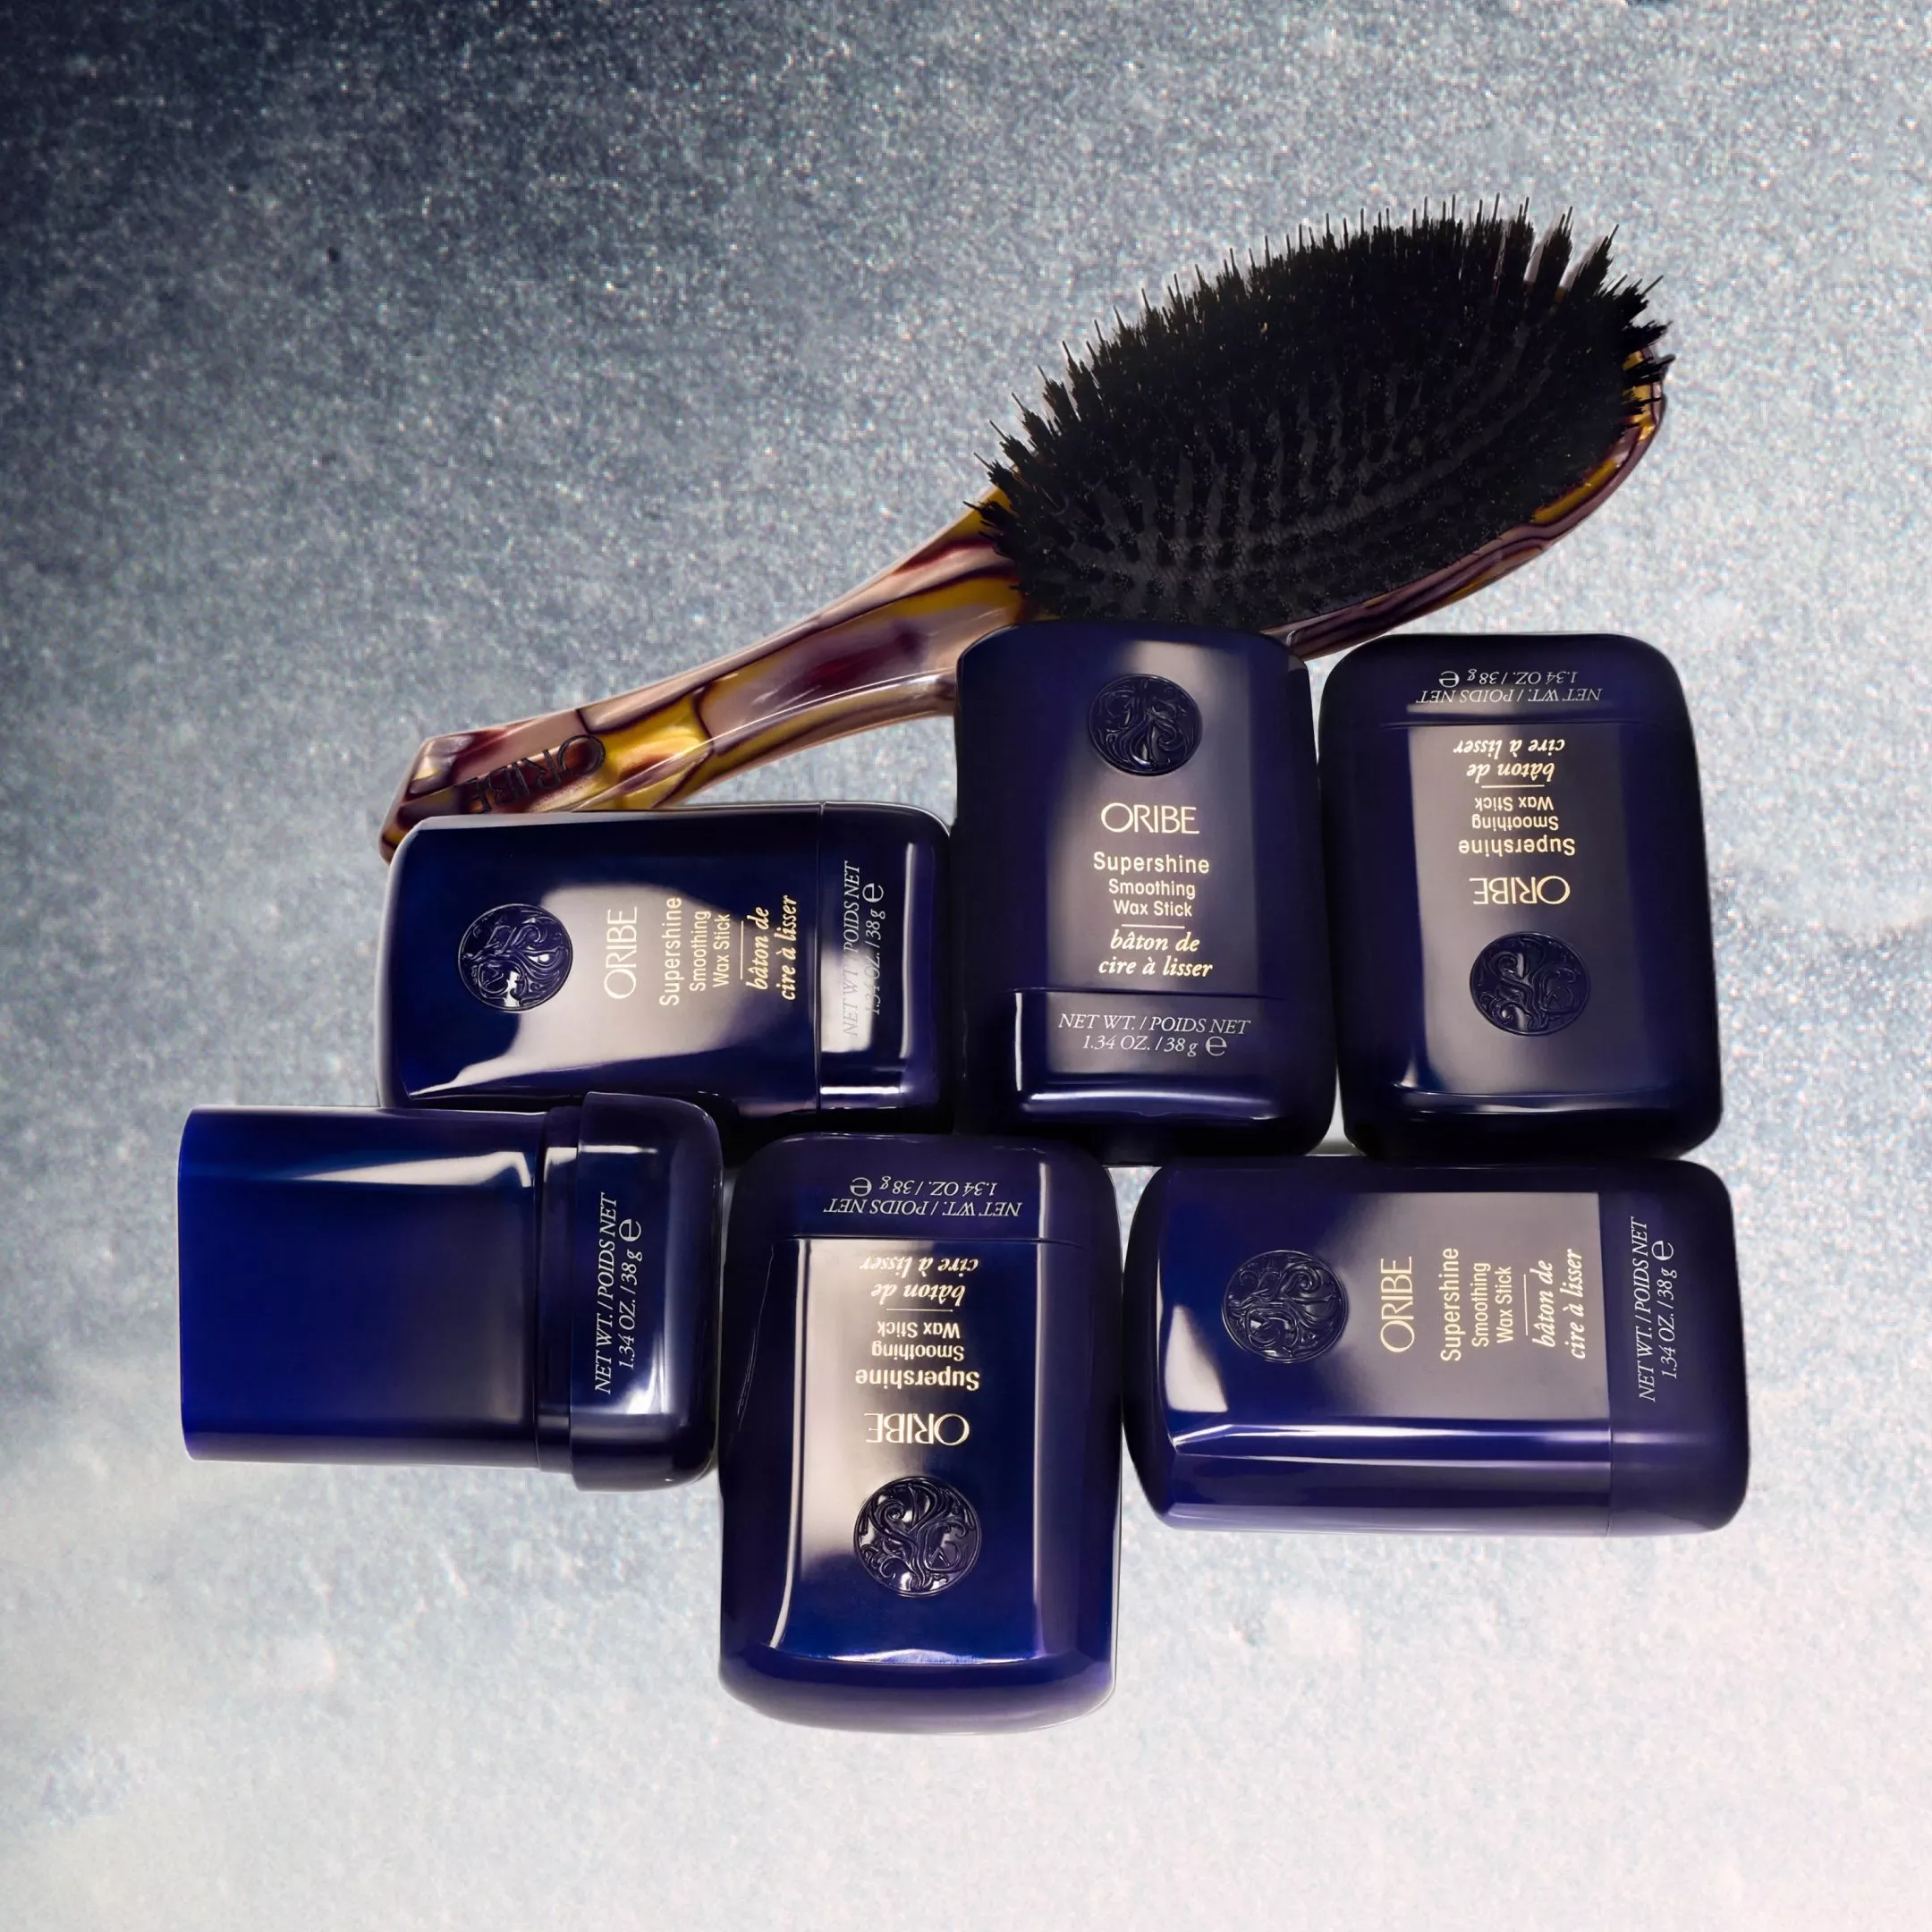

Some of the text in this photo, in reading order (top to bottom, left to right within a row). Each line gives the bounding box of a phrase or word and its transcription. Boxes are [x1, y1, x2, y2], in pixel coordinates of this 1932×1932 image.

[1467, 669, 1477, 681] g
[1479, 673, 1499, 685] 38
[1513, 671, 1540, 684] OZ.
[1547, 672, 1578, 683] 1.34
[1415, 690, 1456, 704] NET
[1460, 689, 1515, 703] POIDS
[1529, 689, 1559, 701] WT.
[1565, 688, 1603, 701] NET
[1453, 739, 1565, 759] cire à lisser
[462, 734, 606, 813] ORIBE
[1466, 762, 1555, 784] bâton de
[1475, 796, 1555, 812] Wax Stick
[1101, 802, 1199, 834] ORIBE
[1472, 814, 1558, 831] Smoothing
[1459, 835, 1575, 857] Supershine
[1093, 852, 1209, 874] Supershine
[844, 860, 860, 899] NET
[1108, 878, 1195, 900] Smoothing
[1470, 876, 1571, 905] ORIBE
[870, 909, 886, 919] g
[1114, 900, 1192, 917] Wax Stick
[843, 901, 859, 953] POIDS
[866, 920, 880, 940] 38
[659, 897, 684, 1005] Supershine
[690, 911, 711, 991] Smoothing
[713, 914, 730, 987] Wax Stick
[746, 907, 769, 989] bâton de
[774, 895, 797, 1000] cire à lisser
[1110, 929, 1200, 952] bâton de
[604, 906, 637, 999] ORIBE
[864, 952, 880, 979] OZ.
[1098, 956, 1213, 978] cire à lisser
[865, 982, 880, 1015] 1.34
[843, 998, 859, 1037] NET
[1059, 1014, 1100, 1029] NET
[1104, 1015, 1135, 1030] WT.
[1149, 1016, 1206, 1033] POIDS
[1209, 1019, 1250, 1035] NET
[1082, 1036, 1115, 1050] 1.34
[1120, 1037, 1149, 1051] OZ.
[1164, 1038, 1185, 1052] 38
[1187, 1041, 1199, 1056] g
[879, 1176, 891, 1190] g
[892, 1179, 915, 1195] 38
[928, 1182, 959, 1196] OZ.
[963, 1182, 998, 1196] 1.34
[599, 1192, 617, 1237] NET
[823, 1199, 868, 1213] NET
[869, 1199, 929, 1215] POIDS
[943, 1201, 976, 1216] WT.
[979, 1202, 1022, 1216] NET
[1631, 1216, 1648, 1257] NET
[627, 1249, 642, 1261] g
[597, 1239, 615, 1300] POIDS
[620, 1262, 637, 1285] 38
[860, 1256, 979, 1278] cire à lisser
[1662, 1268, 1677, 1279] g
[871, 1284, 965, 1306] bâton de
[1633, 1258, 1650, 1314] POIDS
[1656, 1277, 1674, 1301] 38
[620, 1299, 636, 1330] OZ.
[1380, 1257, 1414, 1352] ORIBE
[1439, 1248, 1465, 1361] Supershine
[1471, 1262, 1491, 1347] Smoothing
[1495, 1266, 1513, 1343] Wax Stick
[1530, 1259, 1555, 1347] bâton de
[1560, 1249, 1585, 1359] cire à lisser
[597, 1313, 613, 1349] WT.
[877, 1321, 961, 1338] Wax Stick
[1657, 1313, 1676, 1343] OZ.
[619, 1333, 634, 1369] 1.34
[872, 1341, 963, 1361] Smoothing
[1636, 1326, 1653, 1359] WT.
[595, 1350, 612, 1394] NET
[1660, 1344, 1677, 1379] 1.34
[856, 1366, 979, 1391] Supershine
[1639, 1360, 1656, 1402] NET
[864, 1412, 970, 1445] ORIBE
